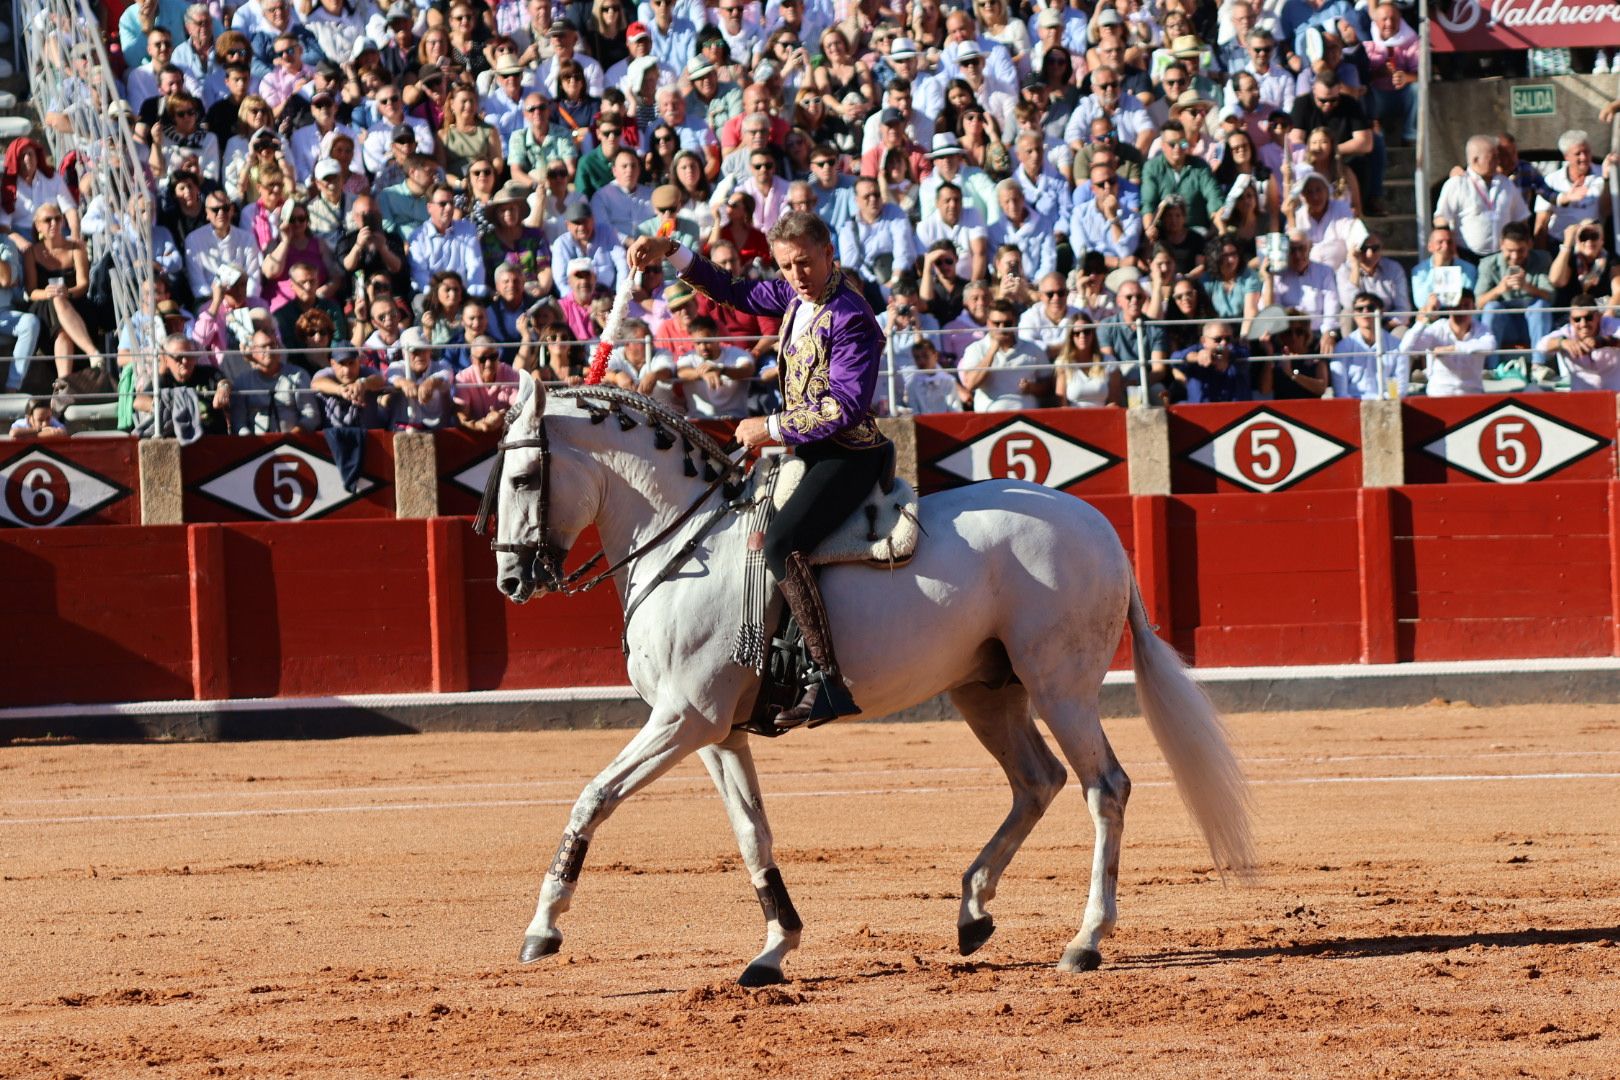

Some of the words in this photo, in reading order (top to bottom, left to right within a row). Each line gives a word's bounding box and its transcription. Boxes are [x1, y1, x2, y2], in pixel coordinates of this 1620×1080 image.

[1514, 90, 1552, 111] SALIDA
[1006, 439, 1036, 485] 5
[1250, 429, 1280, 478] 5
[1495, 423, 1526, 473] 5
[21, 468, 54, 516] 6
[272, 462, 302, 511] 5
